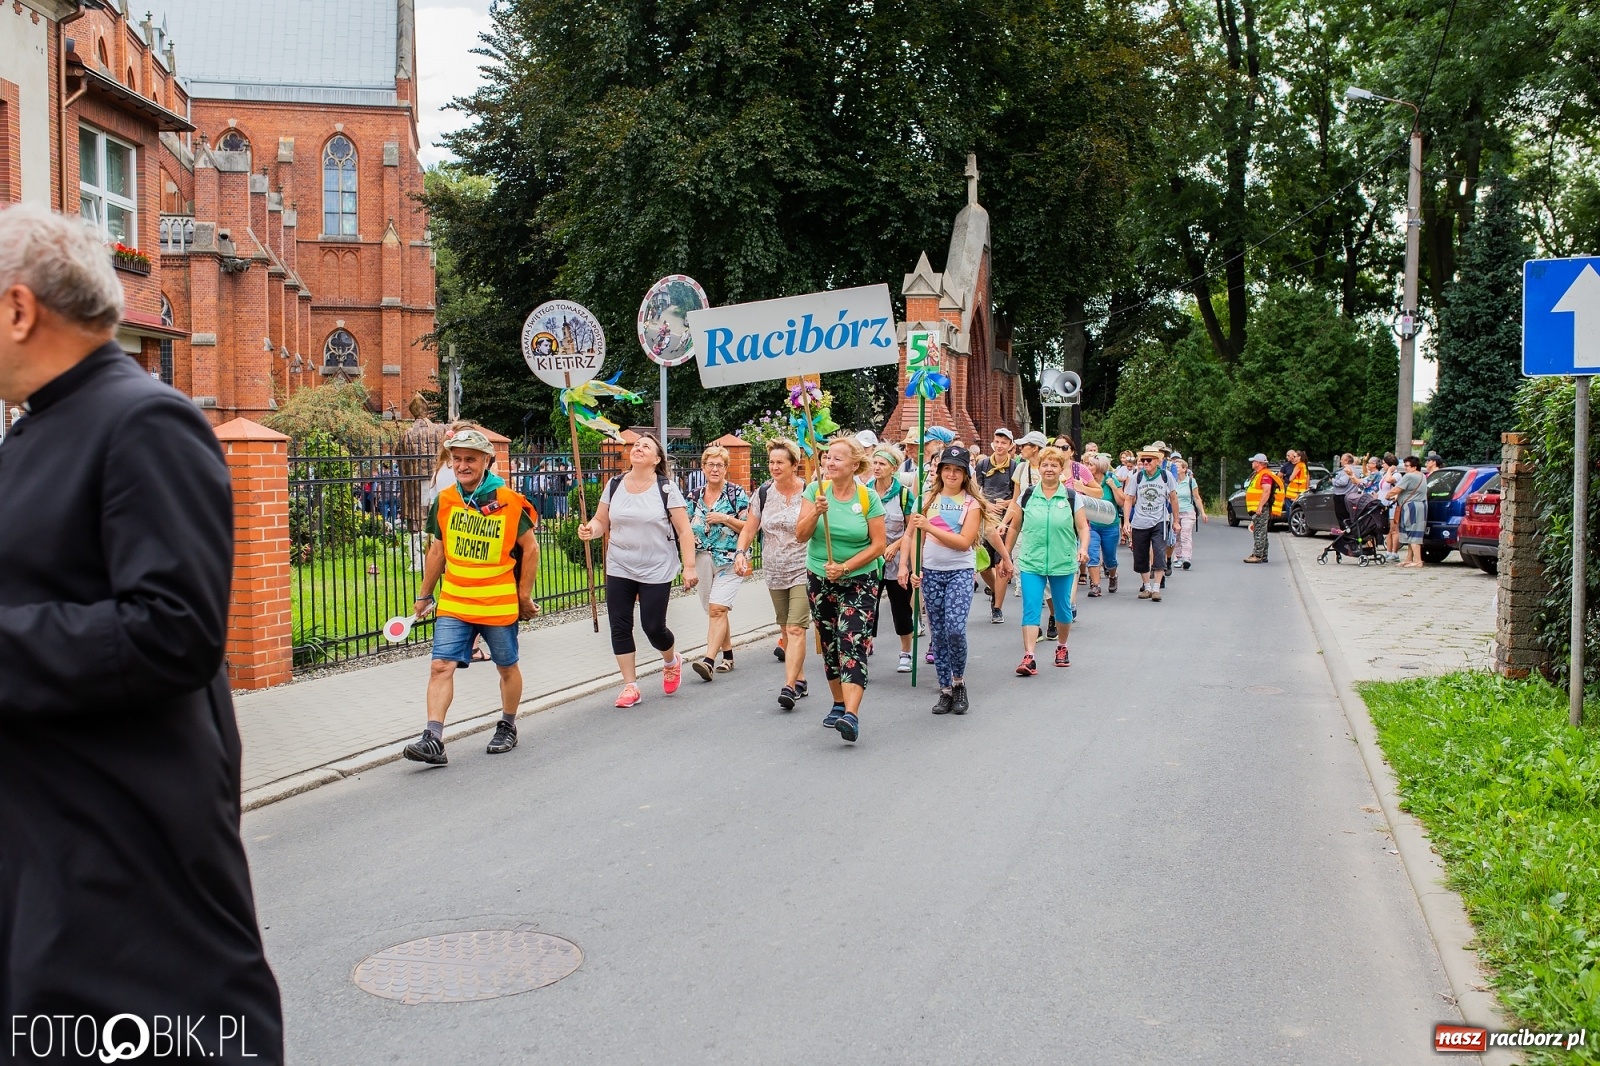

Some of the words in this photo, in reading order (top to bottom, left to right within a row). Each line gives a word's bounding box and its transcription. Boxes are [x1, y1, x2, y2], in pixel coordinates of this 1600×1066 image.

[524, 329, 532, 359] PARAFIA
[528, 304, 555, 329] ŚWIĘTEGO
[556, 303, 589, 321] TOMASZA
[588, 320, 604, 356] APOSTOŁA
[704, 309, 892, 368] Racibórz
[910, 333, 929, 366] 5
[450, 511, 502, 539] KIEROWANIE
[454, 536, 491, 561] RUCHEM
